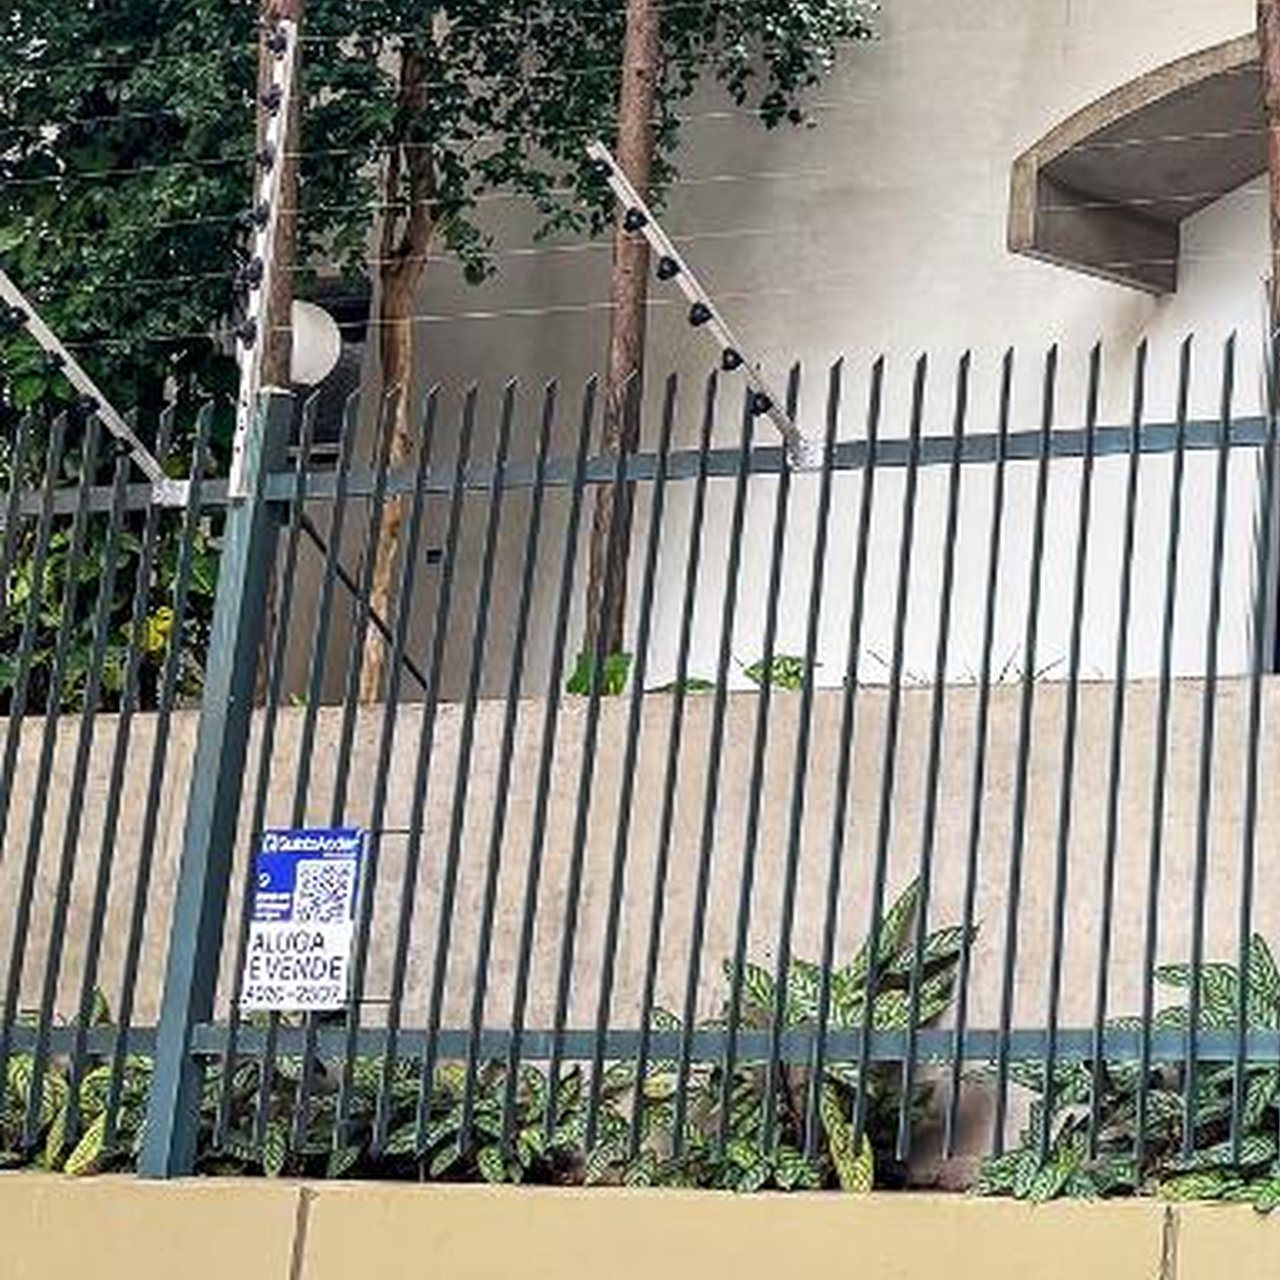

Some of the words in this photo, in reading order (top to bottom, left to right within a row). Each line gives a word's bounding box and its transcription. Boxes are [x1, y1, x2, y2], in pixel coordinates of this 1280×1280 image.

[252, 929, 326, 954] ALUGA
[249, 955, 261, 981] E
[266, 955, 344, 981] VENDE
